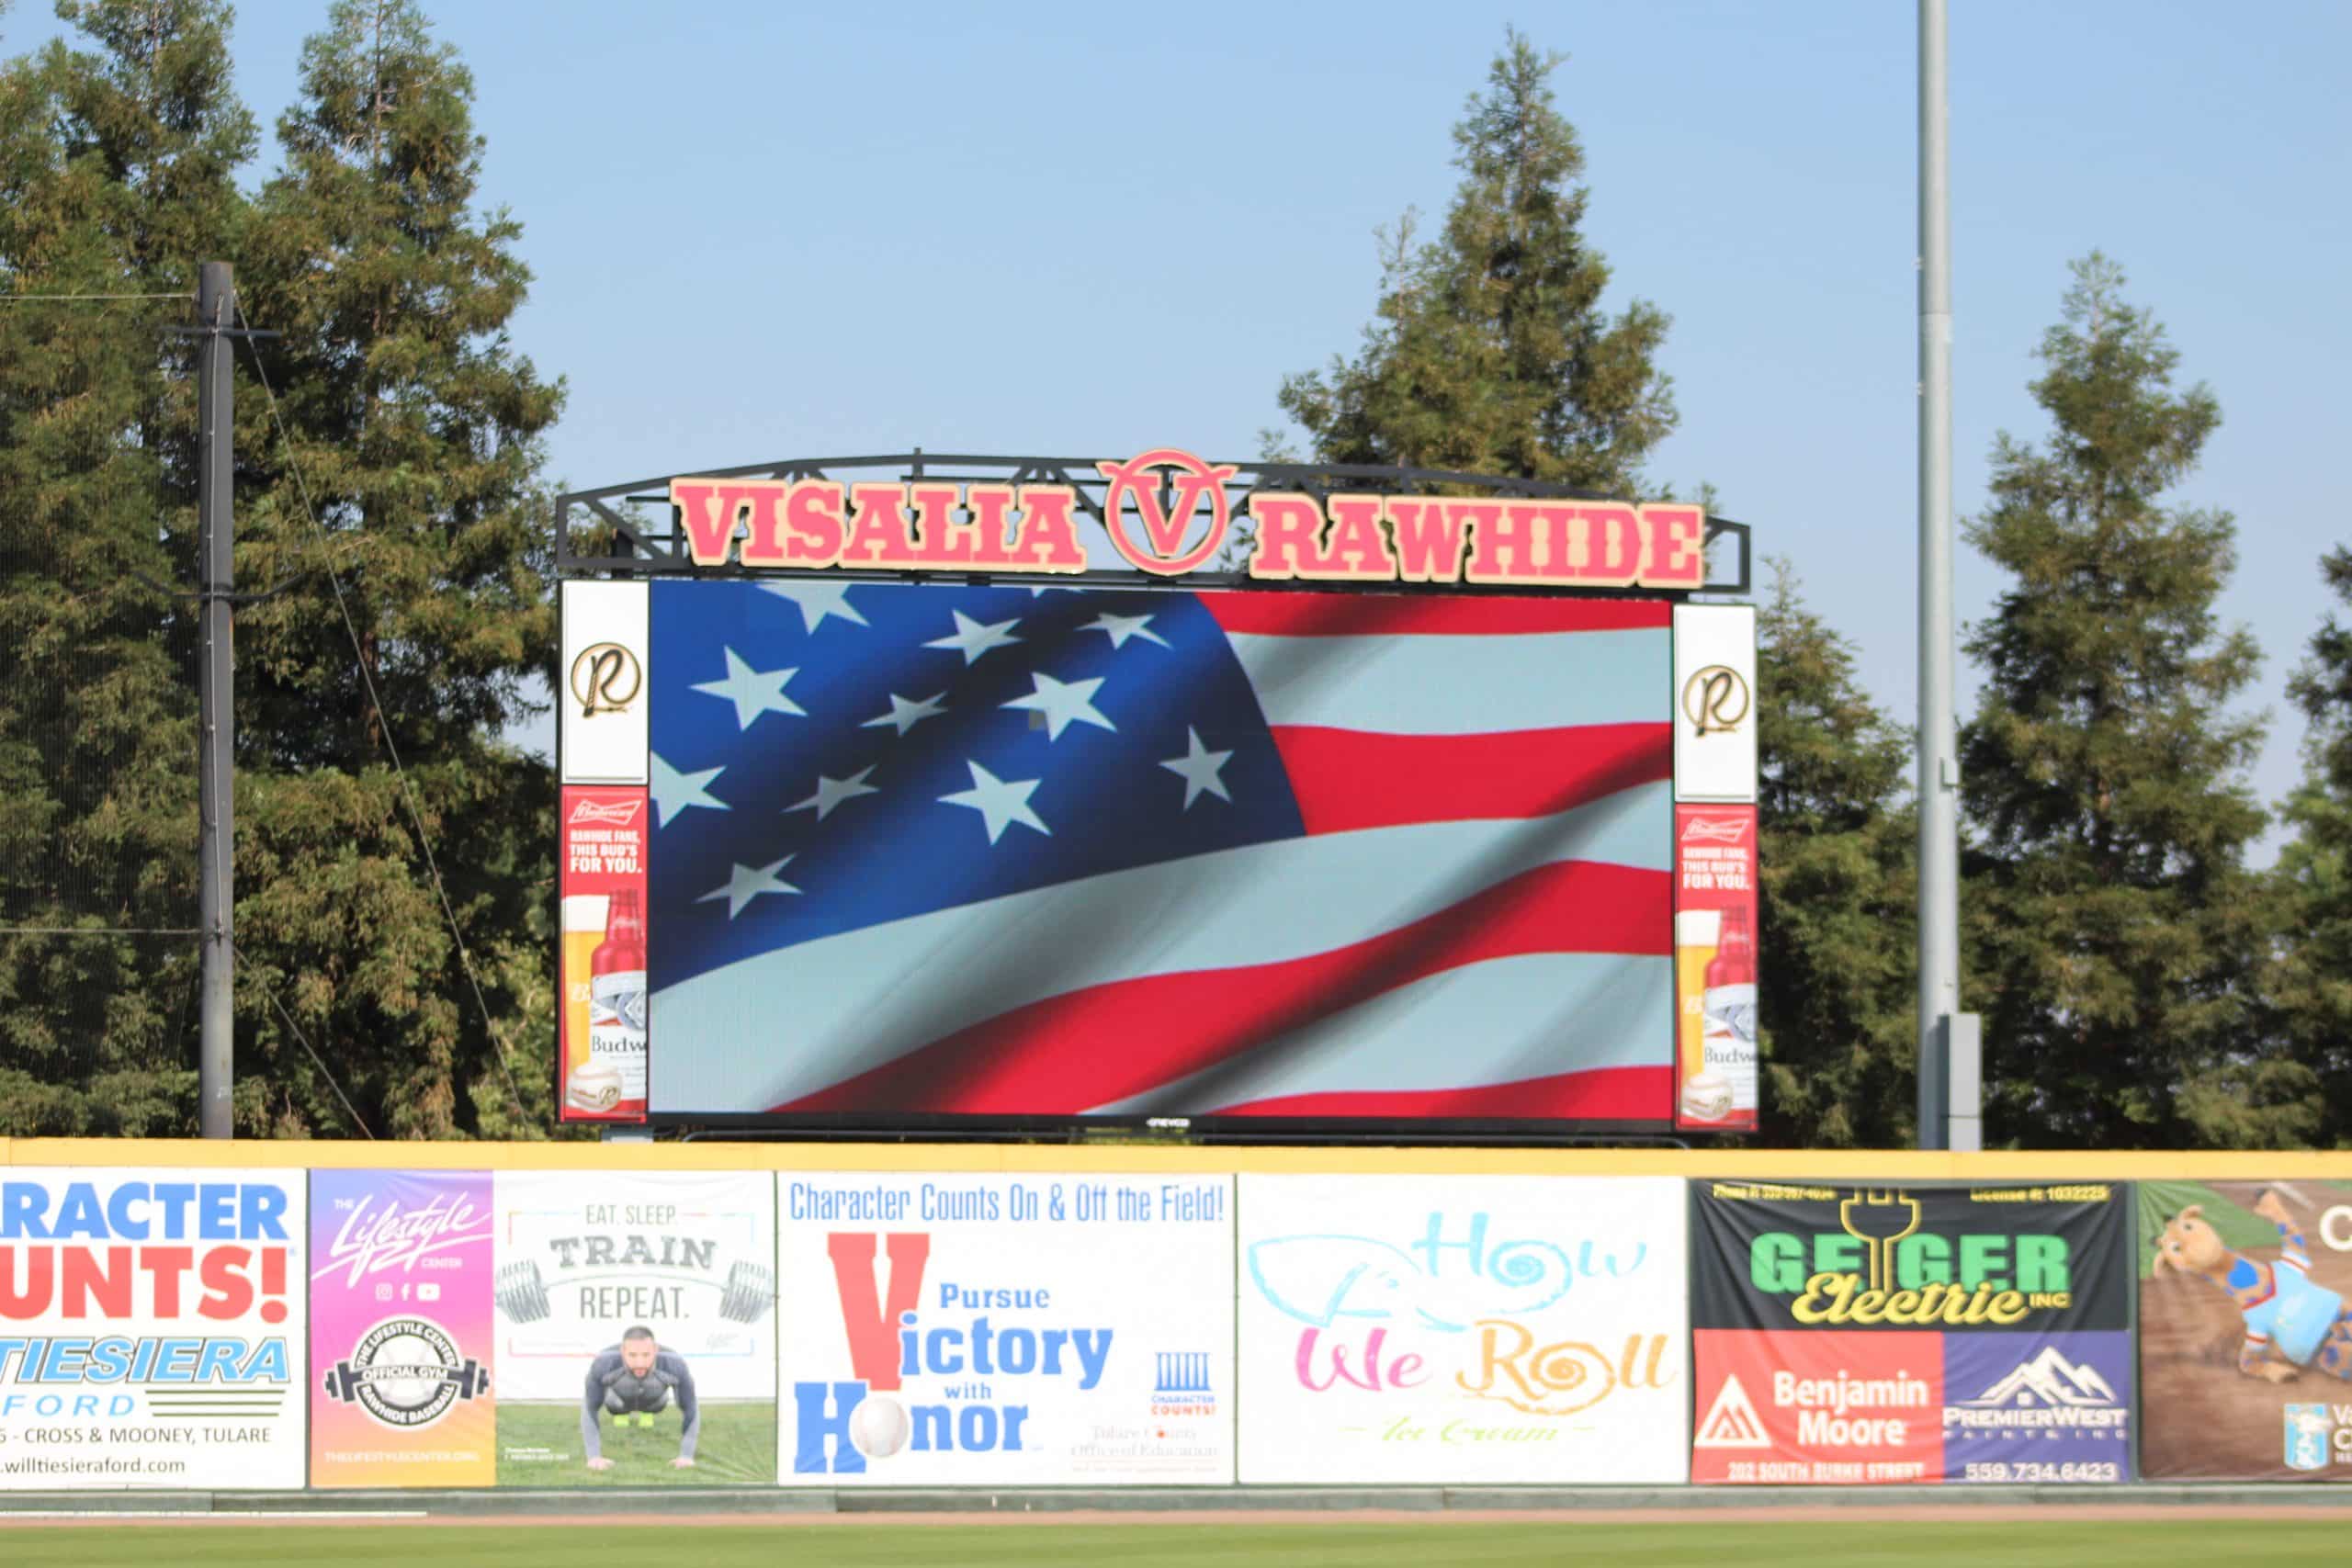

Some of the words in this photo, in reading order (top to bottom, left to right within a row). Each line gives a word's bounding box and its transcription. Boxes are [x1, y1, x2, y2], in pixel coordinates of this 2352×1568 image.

[671, 479, 1087, 573] VISALIA
[1249, 492, 1704, 589] RAWHIDE
[571, 844, 597, 856] THIS
[571, 858, 602, 873] FOR
[605, 858, 642, 874] YOU.
[1683, 874, 1713, 889] FOR
[1715, 874, 1750, 890] YOU.
[0, 1181, 289, 1240] RACTER
[334, 1198, 355, 1210] THE
[586, 1204, 619, 1224] EAT.
[625, 1204, 678, 1224] SLEEP.
[790, 1182, 910, 1221] Character
[922, 1183, 1000, 1221] Counts
[1011, 1183, 1038, 1221] On
[1048, 1183, 1066, 1221] &
[1076, 1183, 1107, 1221] Off
[1117, 1183, 1150, 1221] the
[1161, 1184, 1224, 1221] Field!
[330, 1190, 493, 1289] Lifestyle
[550, 1235, 716, 1270] TRAIN
[421, 1257, 463, 1269] CENTER
[1411, 1212, 1646, 1309] How
[0, 1245, 288, 1324] UNTS!
[940, 1282, 1050, 1309] Pursue
[1791, 1272, 2029, 1325] Electric
[2030, 1292, 2071, 1309] INC
[580, 1287, 690, 1320] REPEAT.
[356, 1346, 371, 1368] THE
[368, 1322, 424, 1348] LIFESTYLE
[424, 1327, 456, 1368] CENTER
[362, 1367, 418, 1380] OFFICIAL
[419, 1368, 448, 1380] GYM
[1295, 1327, 1432, 1392] We
[1454, 1319, 1677, 1416] Roll
[2, 1394, 135, 1417] FORD
[362, 1385, 407, 1423] RAWHIDE
[409, 1385, 454, 1423] BASEBALL
[944, 1381, 992, 1400] with
[1773, 1370, 1928, 1414] Benjamin
[1151, 1405, 1216, 1416] COUNTS!
[24, 1427, 83, 1443] CROSS
[89, 1427, 103, 1443] &
[109, 1427, 197, 1445] MOONEY,
[202, 1427, 271, 1443] TULARE
[1382, 1416, 1426, 1441] Ice
[1440, 1417, 1559, 1444] Cream
[1798, 1411, 1906, 1447] Moore
